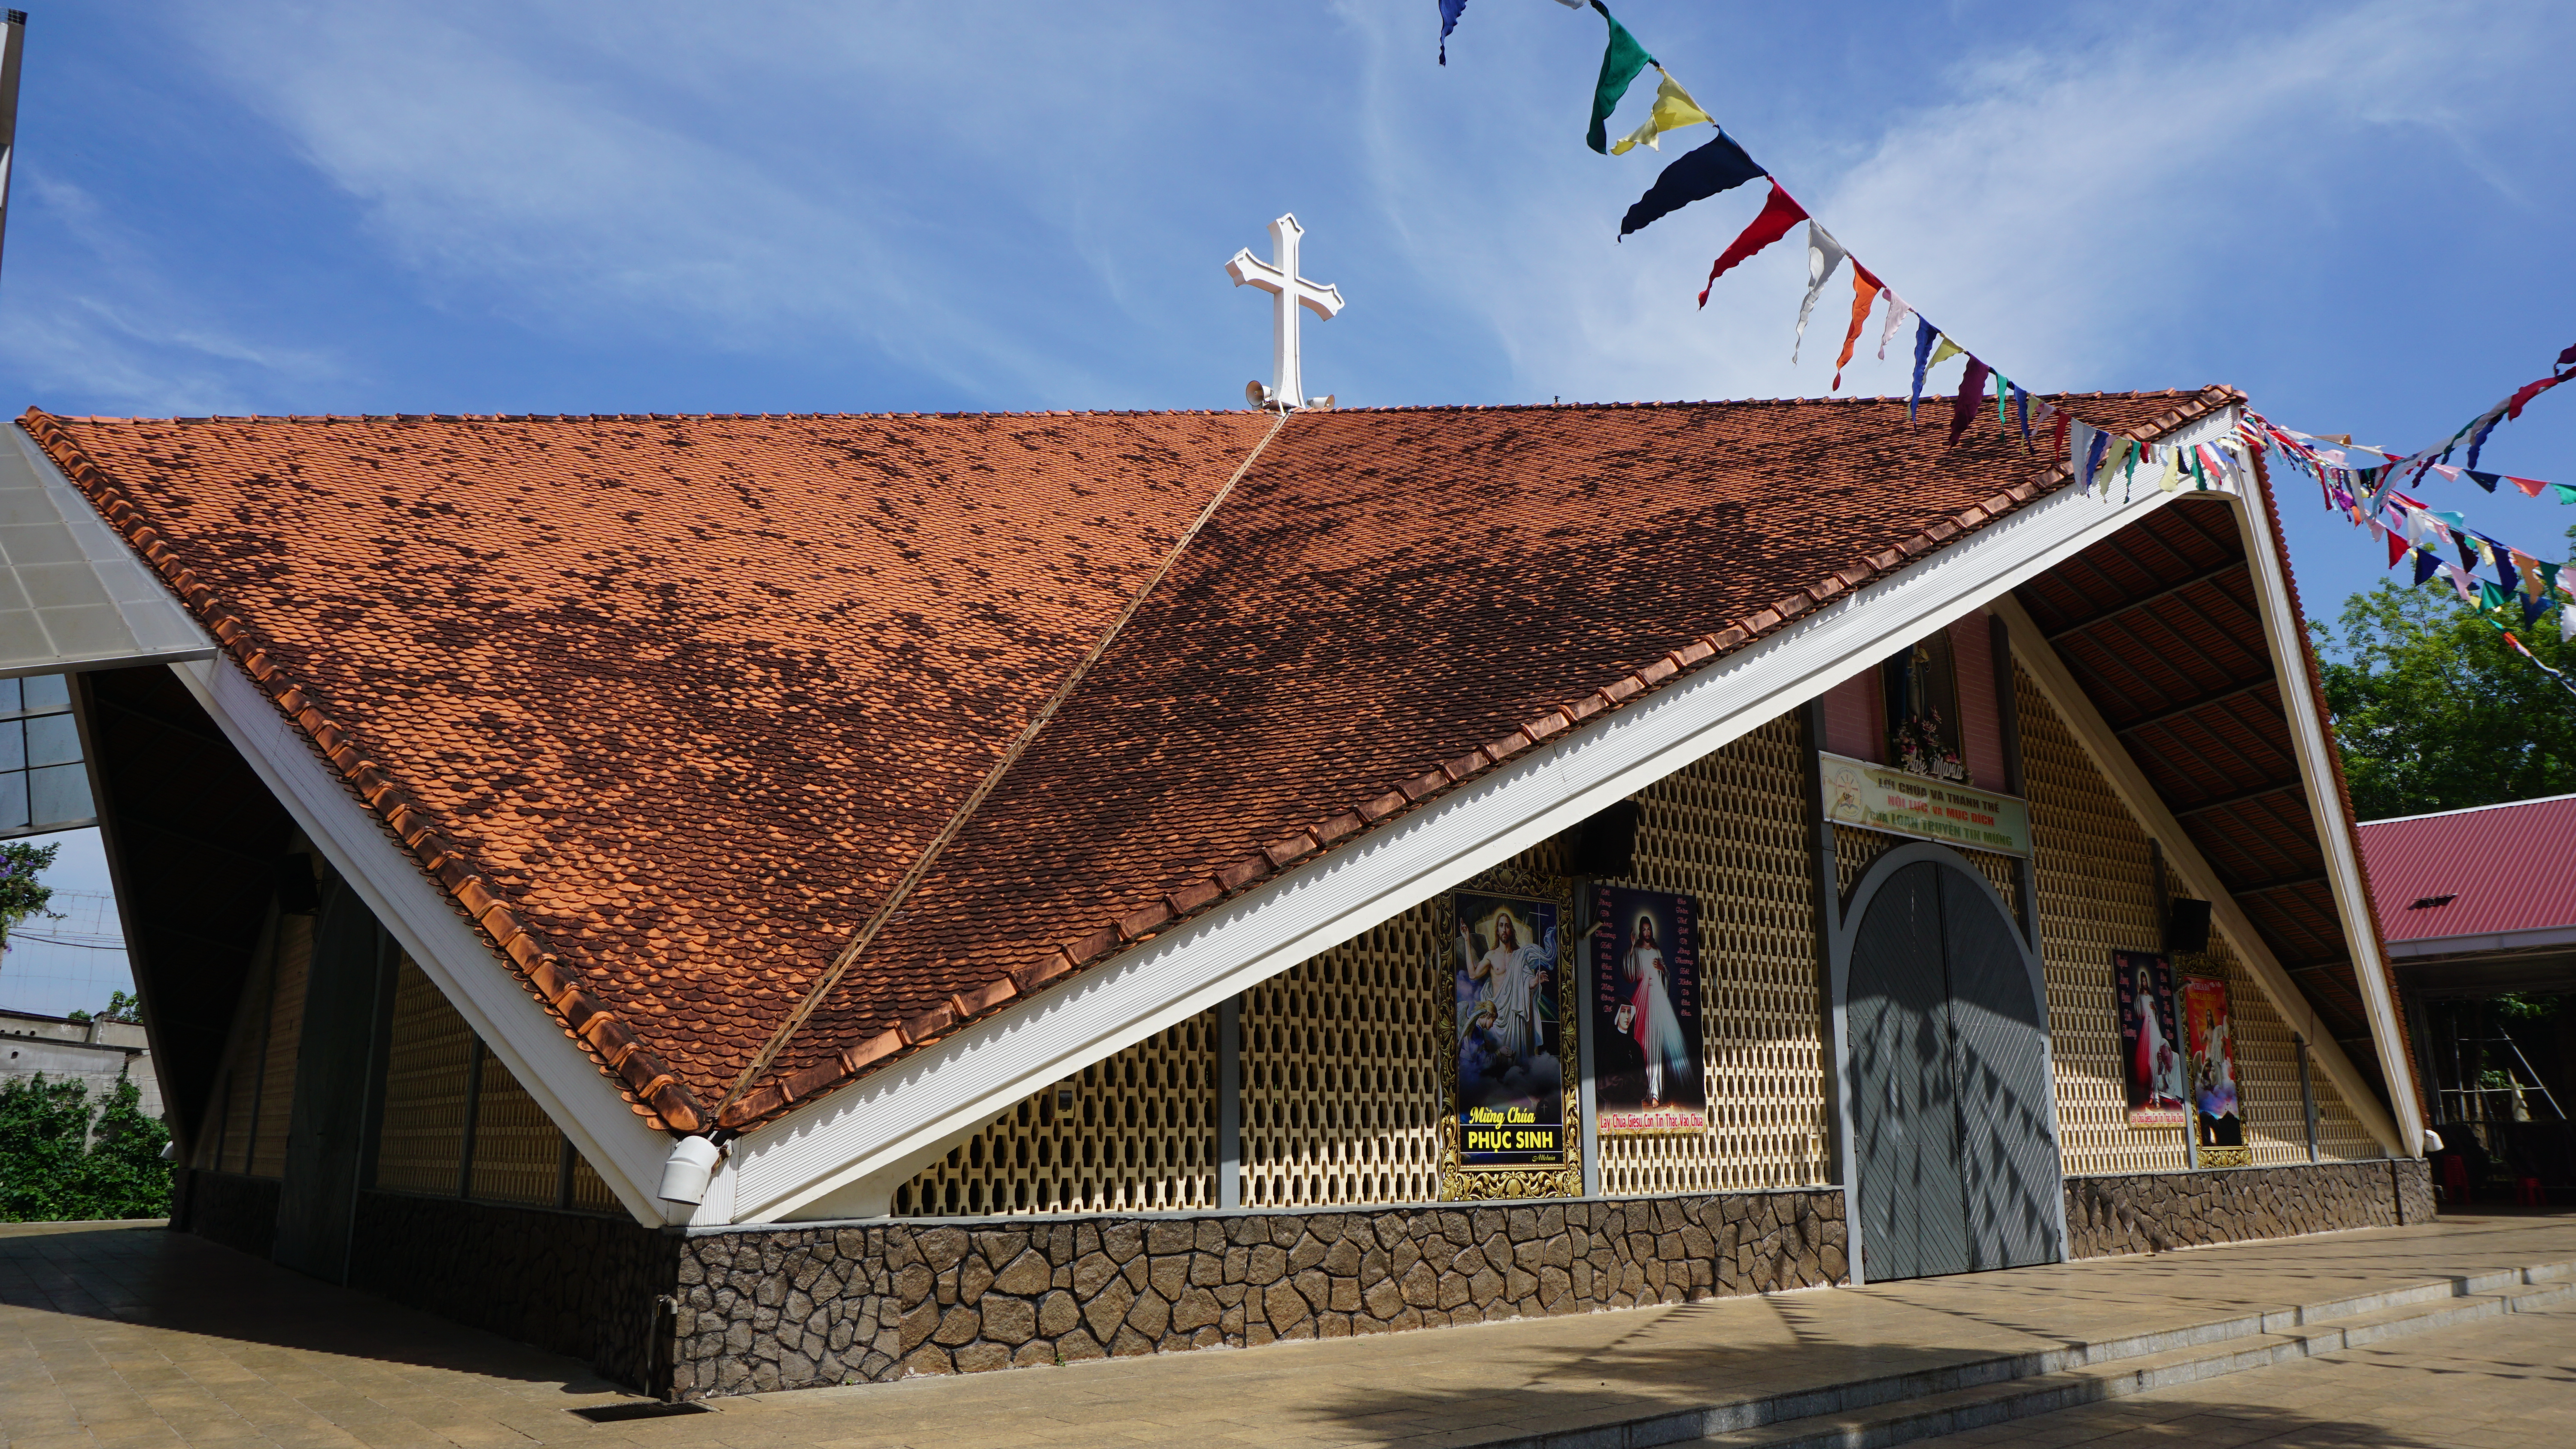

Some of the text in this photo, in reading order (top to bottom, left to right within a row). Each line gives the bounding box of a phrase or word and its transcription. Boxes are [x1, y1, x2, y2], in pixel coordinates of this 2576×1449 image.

[1929, 752, 1964, 779] Maria
[1878, 777, 1895, 790] LỜI
[1898, 782, 1928, 797] CHÚA
[1930, 789, 1944, 801] VÀ
[1946, 793, 1979, 809] THÁNH
[1887, 795, 1994, 826] NỘI LỰC VÀ MỤC ĐÍCH
[1891, 813, 1919, 829] LOAN
[1921, 819, 1960, 837] TRUYỀN
[1964, 827, 1981, 840] TIN
[1983, 831, 2013, 846] MỪNG
[1469, 1106, 1535, 1129] Mừng Chúa
[1600, 1112, 1703, 1133] Lạy Chúa Giêsu Con Tín Thác Vào Chúa
[1468, 1131, 1552, 1153] PHỤC SINH
[1532, 1153, 1556, 1162] Alleluia
